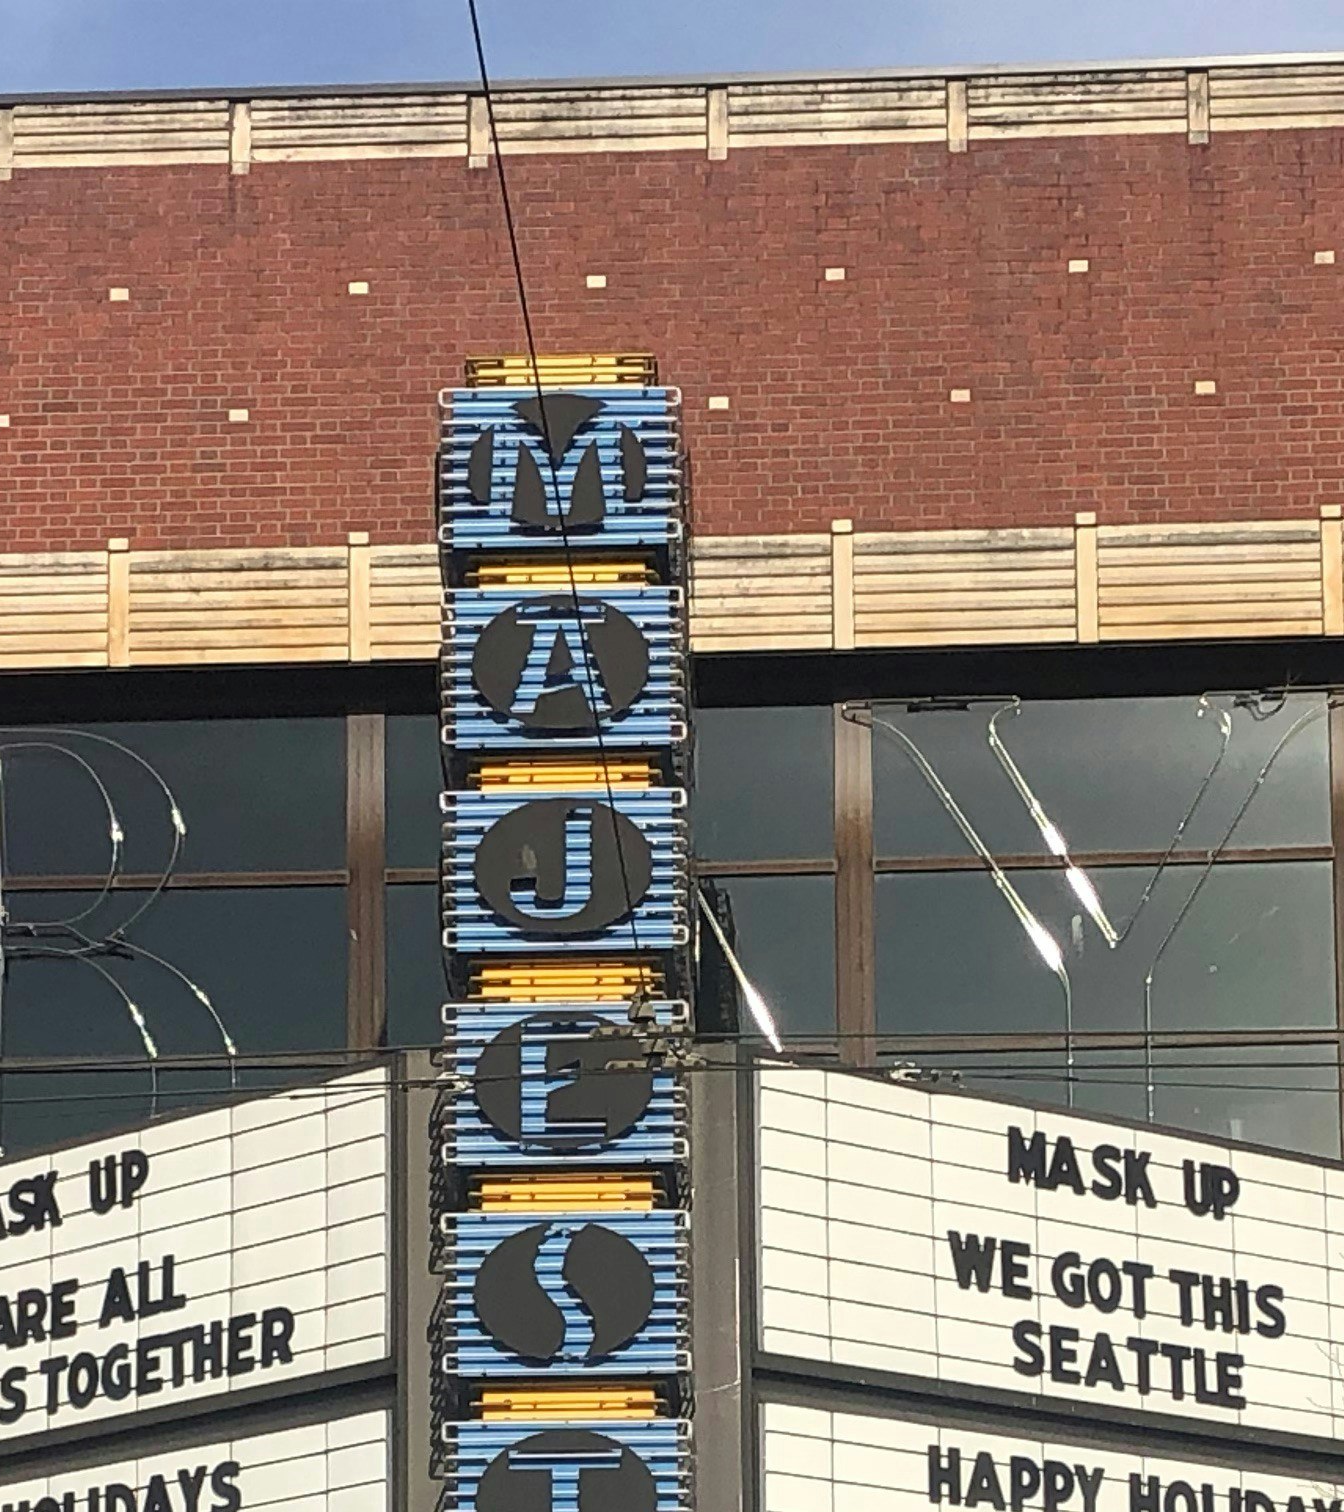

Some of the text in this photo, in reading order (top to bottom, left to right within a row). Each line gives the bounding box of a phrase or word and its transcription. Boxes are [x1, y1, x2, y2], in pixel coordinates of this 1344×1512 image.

[90, 1150, 150, 1215] UP
[1008, 1126, 1241, 1221] MASK UP
[100, 1256, 186, 1329] ALL
[948, 1231, 1287, 1340] WE GOT THIS
[40, 1308, 296, 1415] TOGETHER
[1013, 1320, 1247, 1410] SEATTLE
